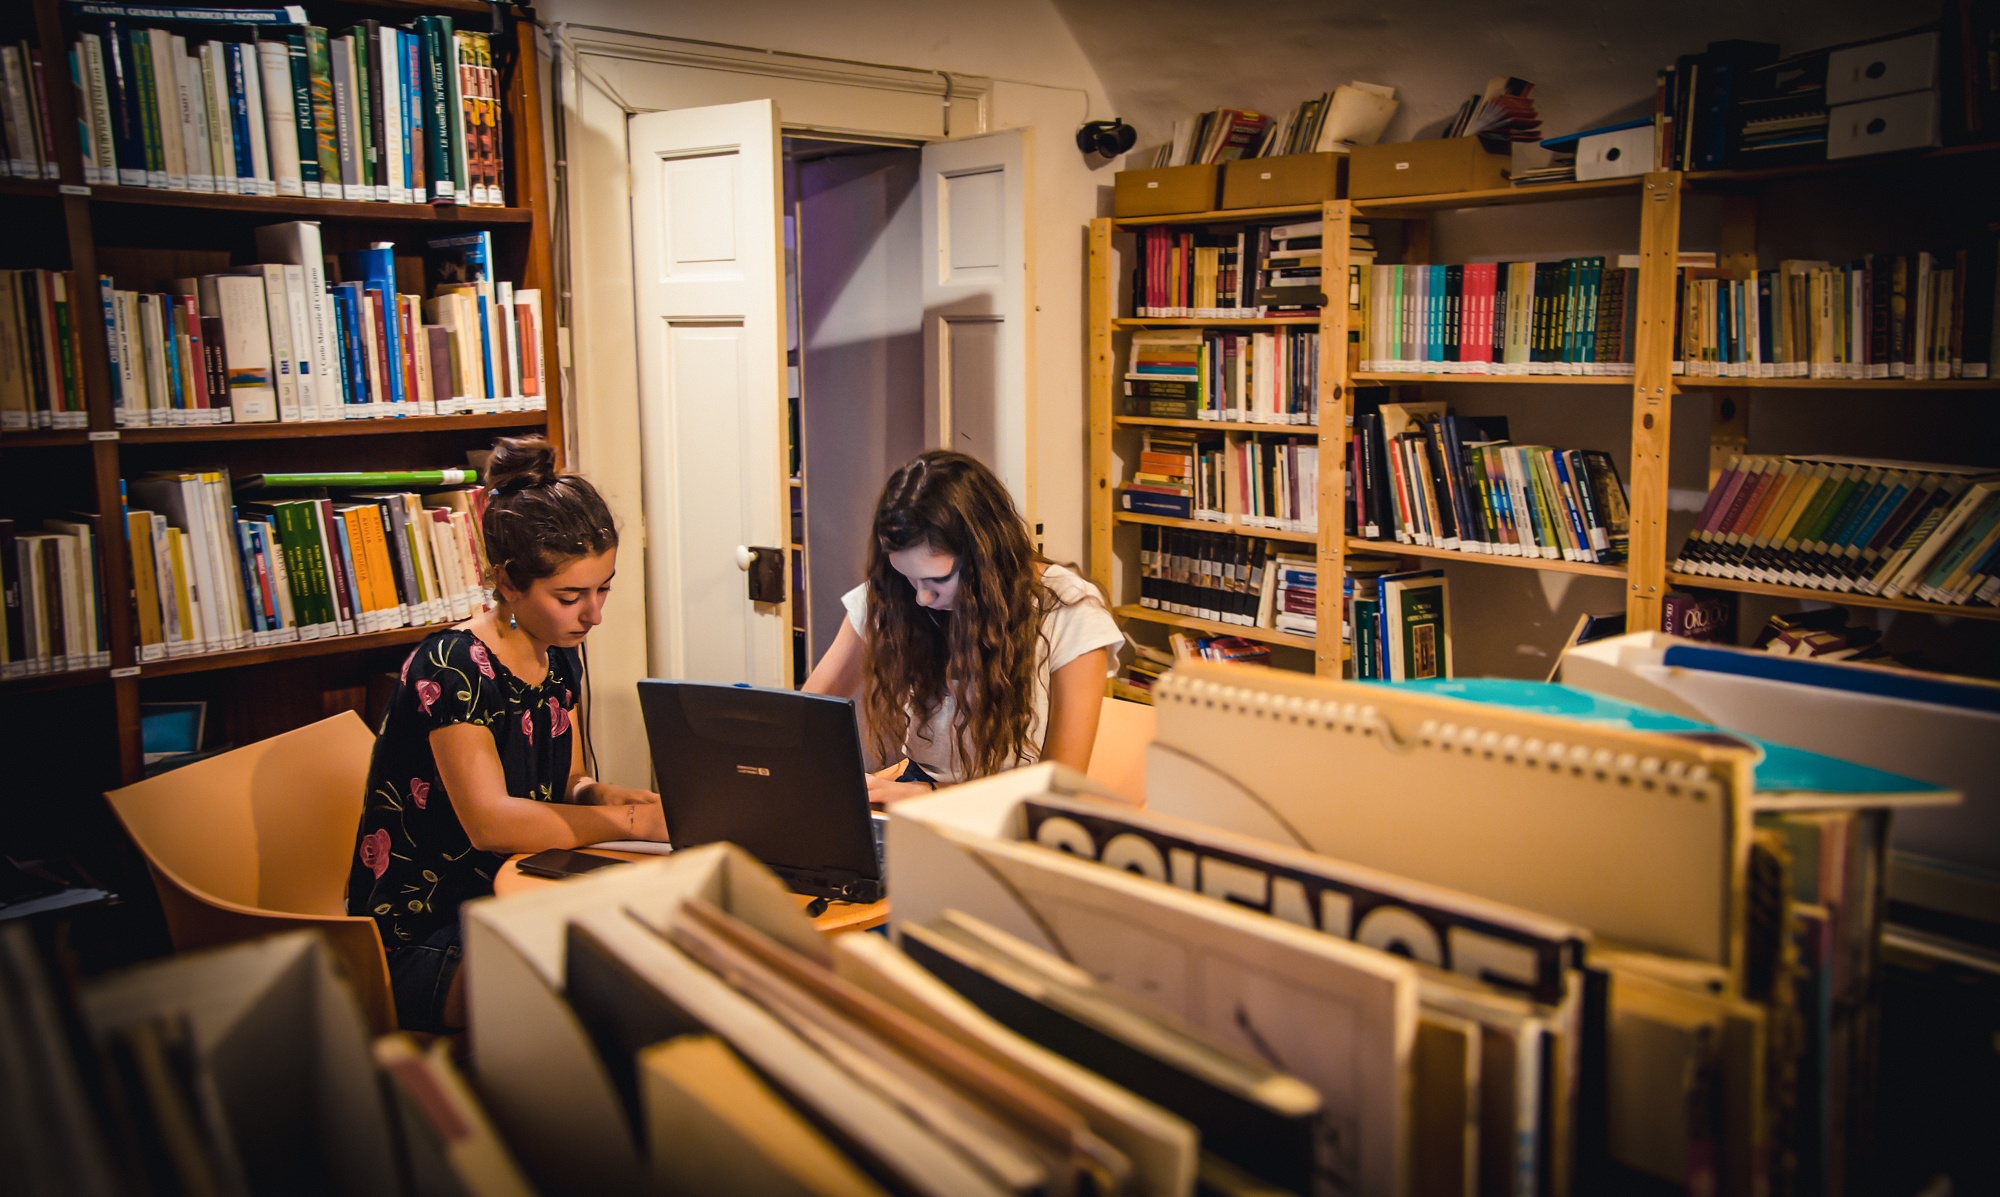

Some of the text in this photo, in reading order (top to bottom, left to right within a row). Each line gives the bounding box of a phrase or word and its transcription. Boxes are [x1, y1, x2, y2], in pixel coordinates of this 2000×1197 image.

[434, 62, 443, 89] PUGLIA
[296, 87, 312, 129] PUGLIA
[437, 91, 444, 99] DI
[310, 75, 337, 153] PUGLIA
[437, 102, 447, 136] MASSERIE
[386, 105, 400, 180] BASILICATA
[440, 138, 448, 147] LE
[310, 267, 327, 375] Le Cento Masserie di Crispiano
[279, 360, 289, 374] Bit
[362, 517, 371, 543] APULIA
[372, 516, 382, 543] APULIA
[256, 553, 265, 574] MOSCA
[275, 549, 286, 580] MOSCA
[356, 553, 367, 580] PUGLIA
